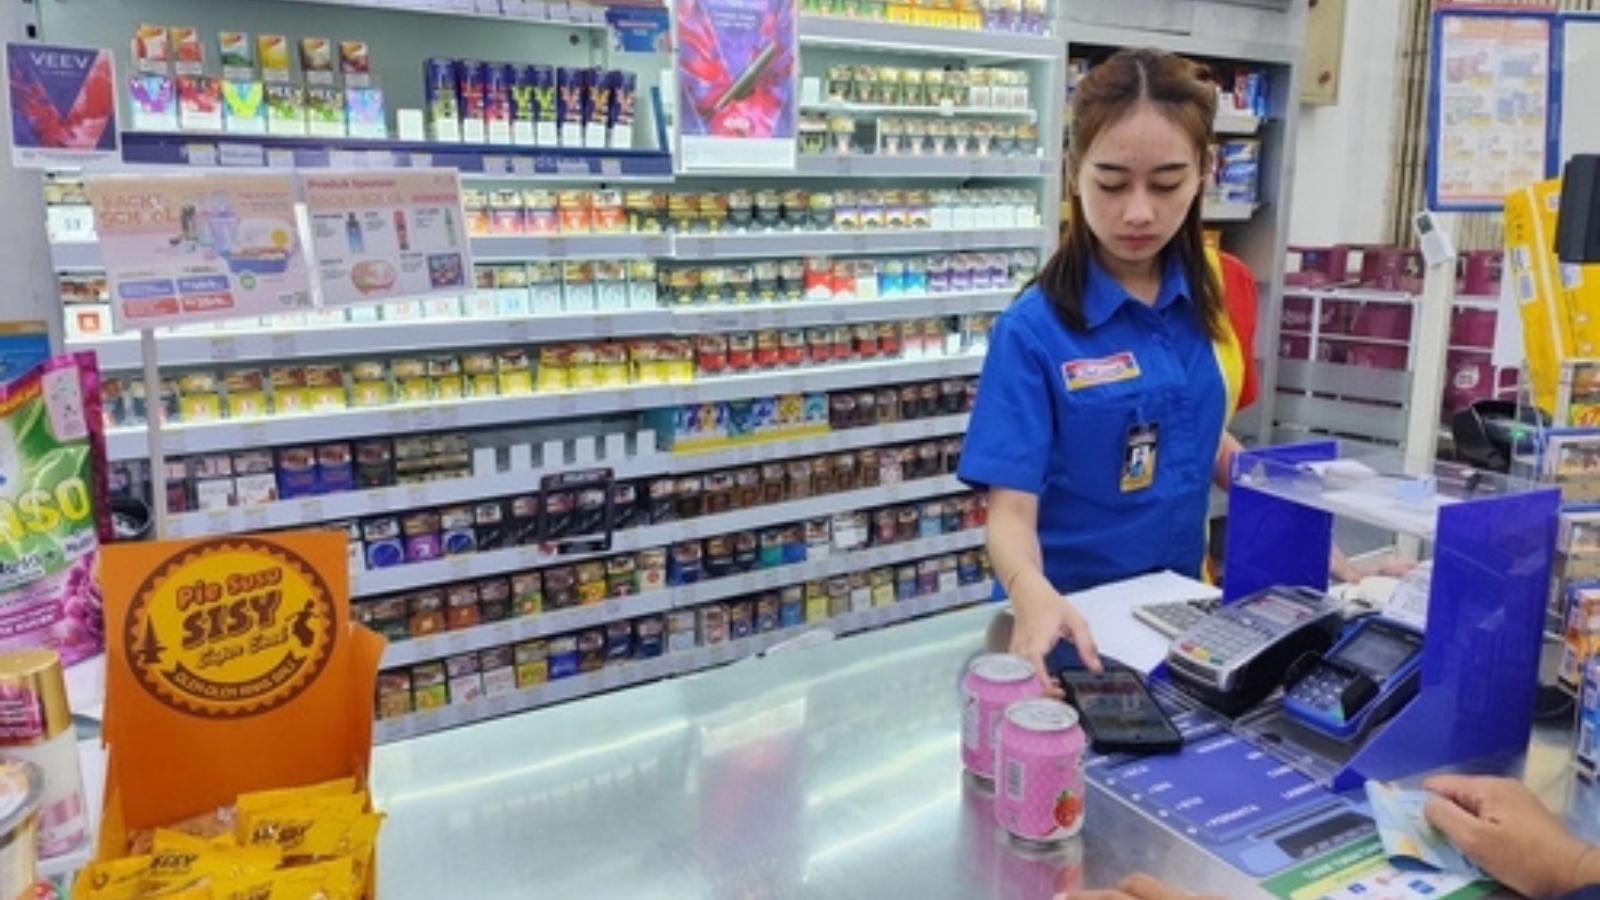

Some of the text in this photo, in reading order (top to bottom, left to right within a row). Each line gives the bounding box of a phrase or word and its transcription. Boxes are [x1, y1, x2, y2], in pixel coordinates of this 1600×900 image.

[29, 51, 89, 68] VEEV
[176, 567, 282, 609] Pie Susu
[182, 590, 282, 649] SISY
